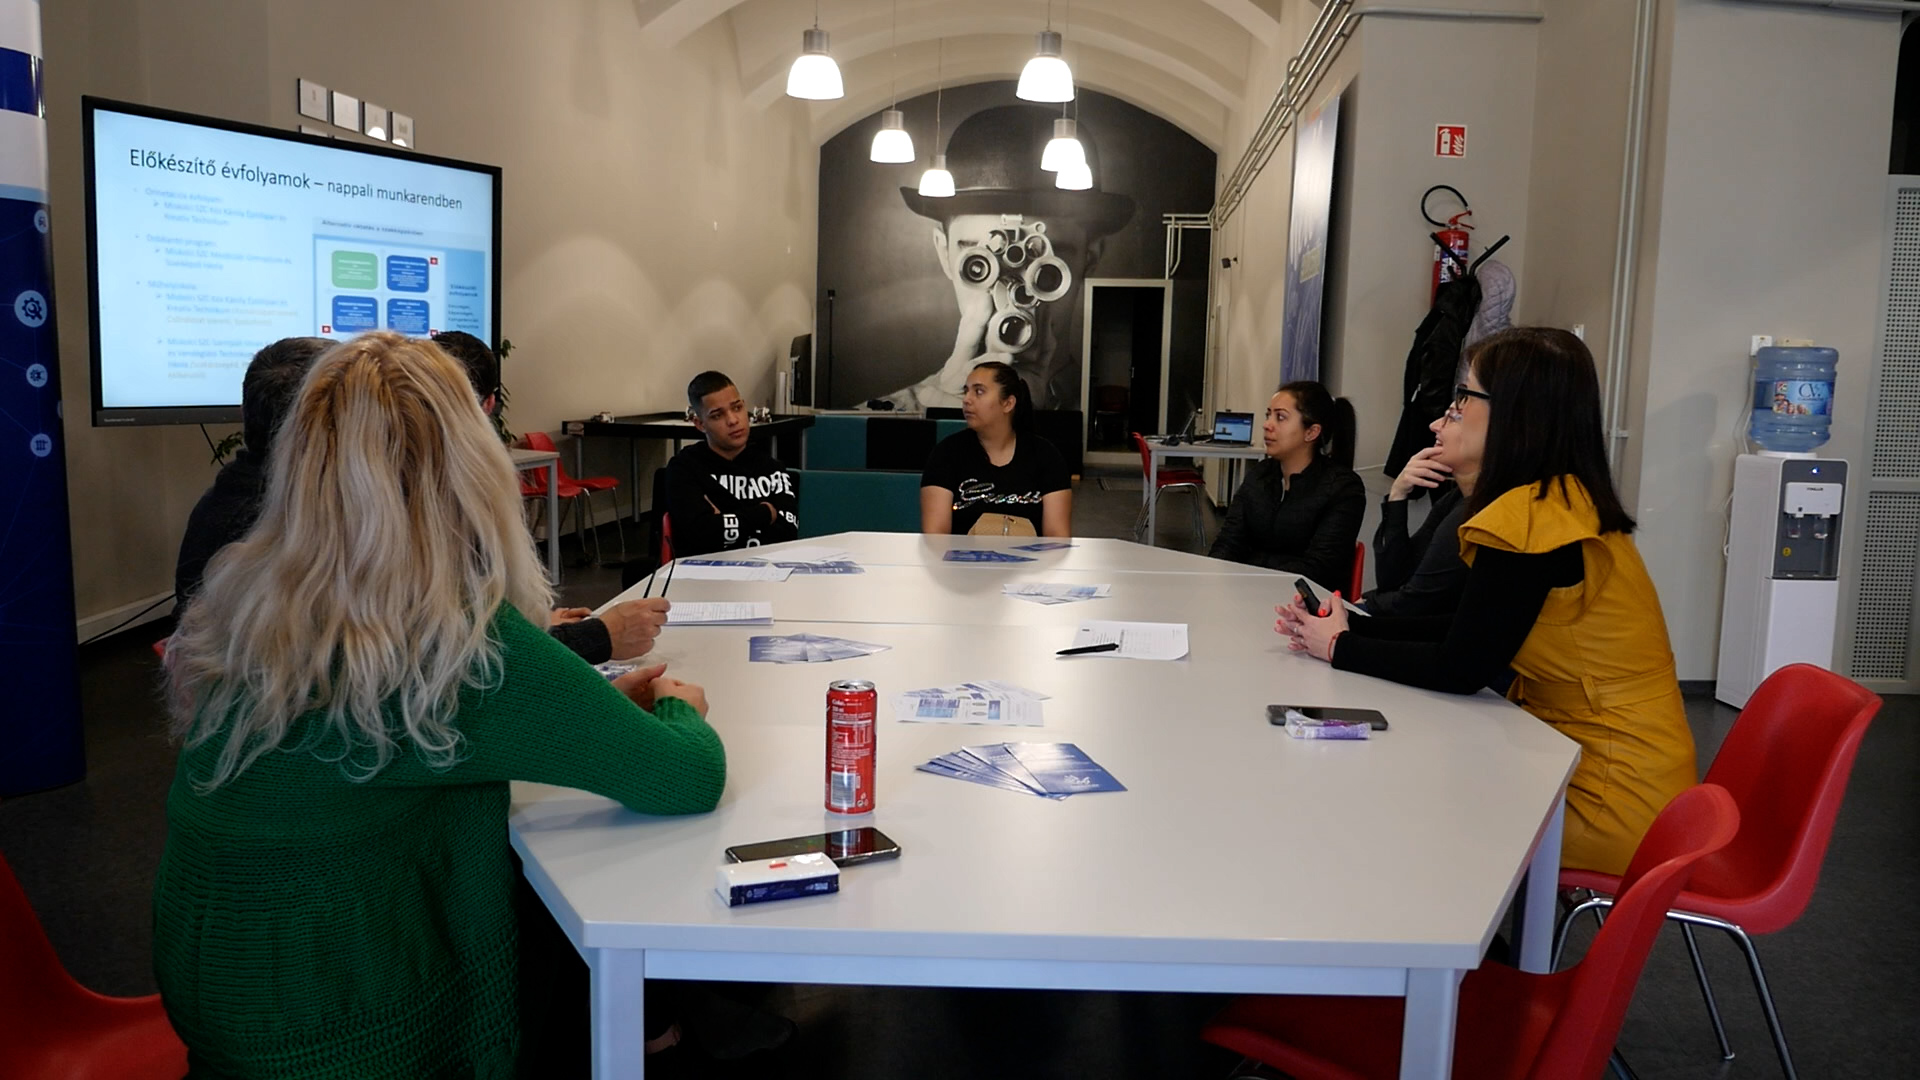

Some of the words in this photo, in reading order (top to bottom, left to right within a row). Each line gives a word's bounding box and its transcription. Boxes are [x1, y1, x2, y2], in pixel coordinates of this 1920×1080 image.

[130, 149, 216, 176] Előkészítő
[221, 161, 310, 187] évfolyamok
[327, 181, 373, 198] nappali
[377, 188, 462, 209] munkarendben
